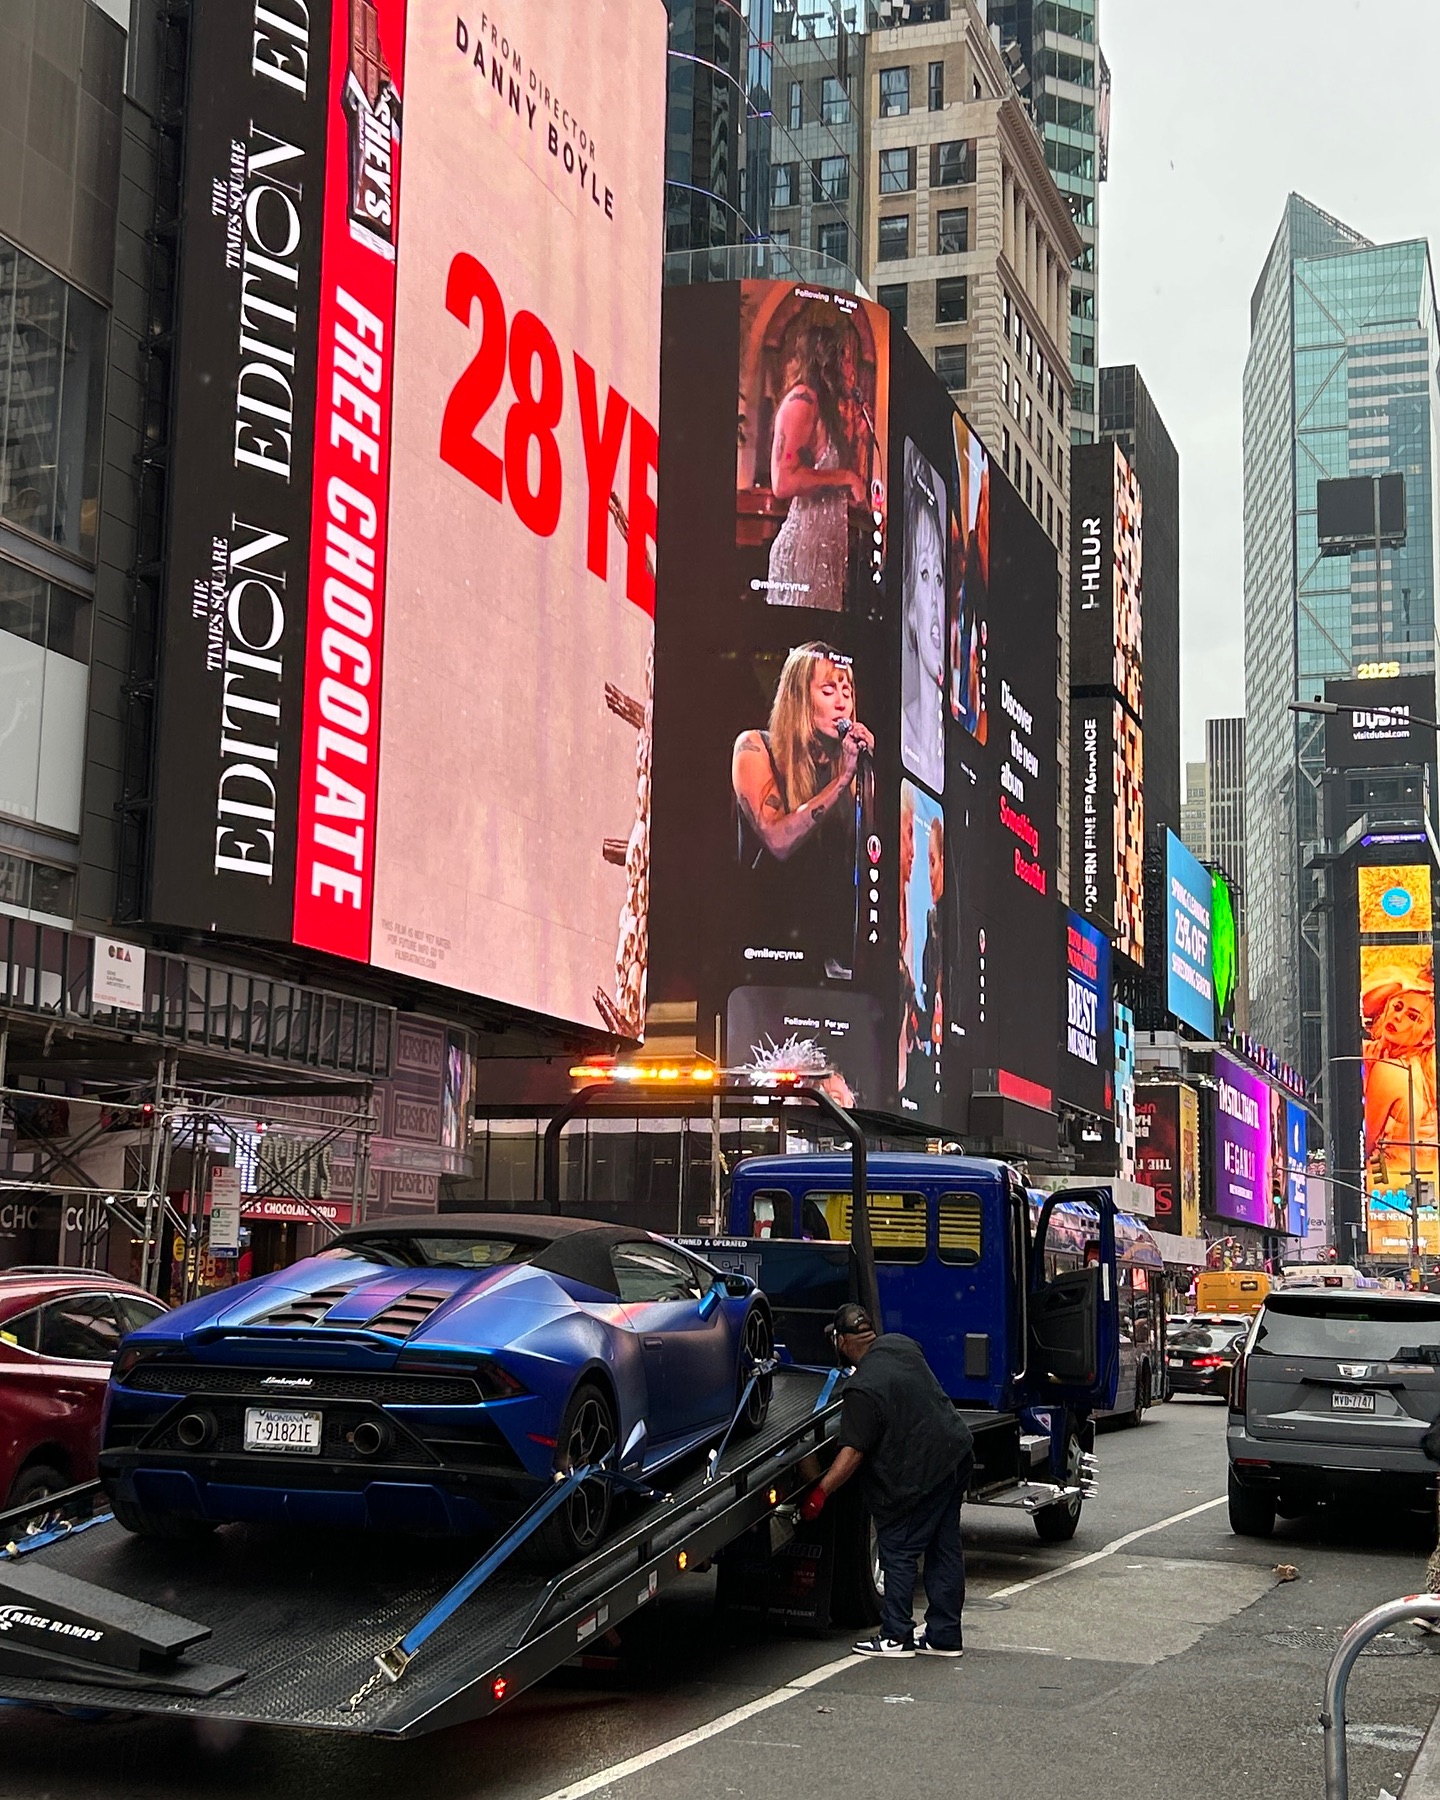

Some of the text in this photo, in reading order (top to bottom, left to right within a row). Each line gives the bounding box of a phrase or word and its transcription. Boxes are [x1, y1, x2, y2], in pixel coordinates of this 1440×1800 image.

[482, 11, 596, 162] FROM DIRECTOR
[456, 15, 614, 221] DANNY BOYLE
[211, 178, 228, 216] THE
[225, 139, 248, 269] TIMES SQUARE
[234, 119, 306, 485] EDITION
[795, 288, 830, 303] Following
[440, 252, 563, 537] 28
[192, 579, 209, 618] THE
[206, 536, 230, 671] TIMES SQUARE
[311, 285, 384, 911] FREE CHOCOLATE
[1357, 661, 1400, 680] 2025
[214, 512, 289, 885] EDITION
[1001, 679, 1033, 735] Discover
[1352, 705, 1410, 729] DUBAI
[1010, 729, 1039, 778] the new
[1353, 730, 1410, 740] visitdubai.com
[1001, 761, 1024, 802] album
[1000, 795, 1039, 858] Something
[1015, 847, 1047, 895] Beautiful
[744, 948, 804, 961] @mileycyrus
[1174, 908, 1208, 967] 25% OFF
[784, 1017, 820, 1028] Following
[1067, 977, 1098, 1037] BEST
[1067, 1025, 1098, 1066] MUSICAL
[1148, 1158, 1172, 1170] THE
[264, 1202, 310, 1216] CHOCOLATE
[1370, 1213, 1386, 1221] THE
[1386, 1213, 1408, 1221] NEW
[677, 1238, 702, 1246] OWNED
[704, 1239, 711, 1247] &
[712, 1239, 748, 1248] OPERATED
[265, 1412, 304, 1423] MONTANA
[10, 1611, 104, 1642] RACE RAMPS
